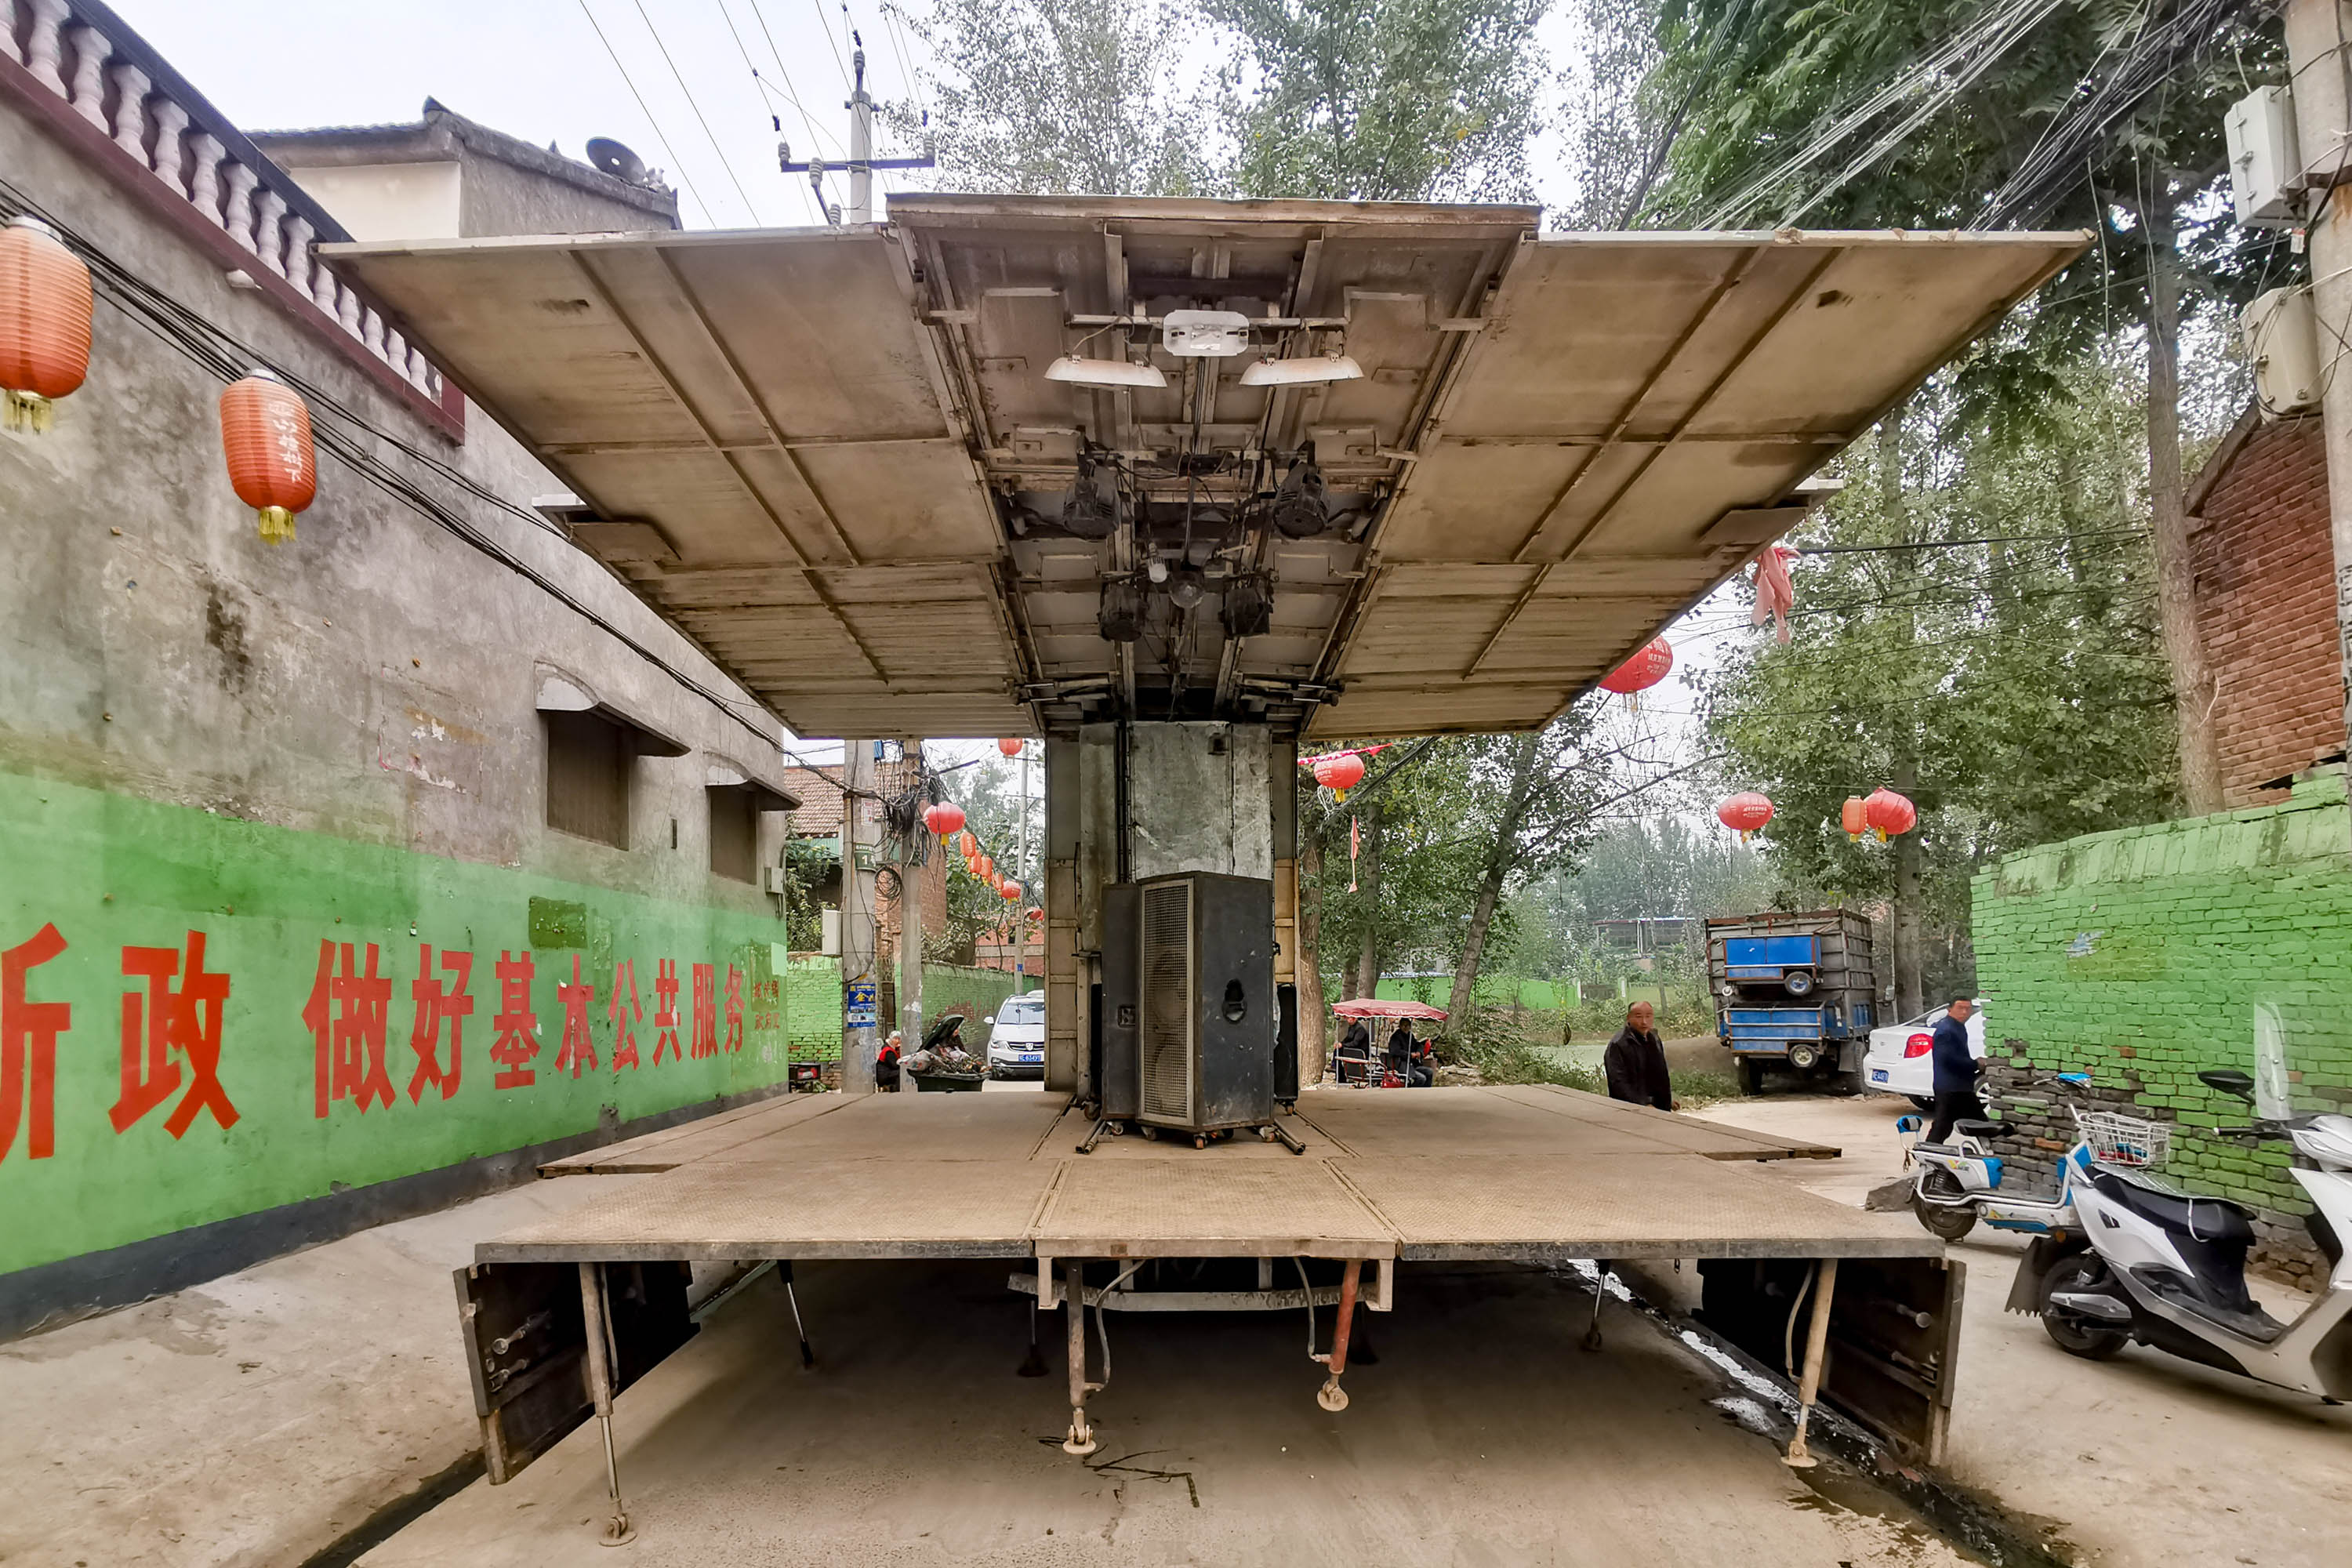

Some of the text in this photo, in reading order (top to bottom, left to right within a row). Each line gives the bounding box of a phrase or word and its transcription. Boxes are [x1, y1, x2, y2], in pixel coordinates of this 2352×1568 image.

[301, 938, 746, 1119] 做好基本公共服务
